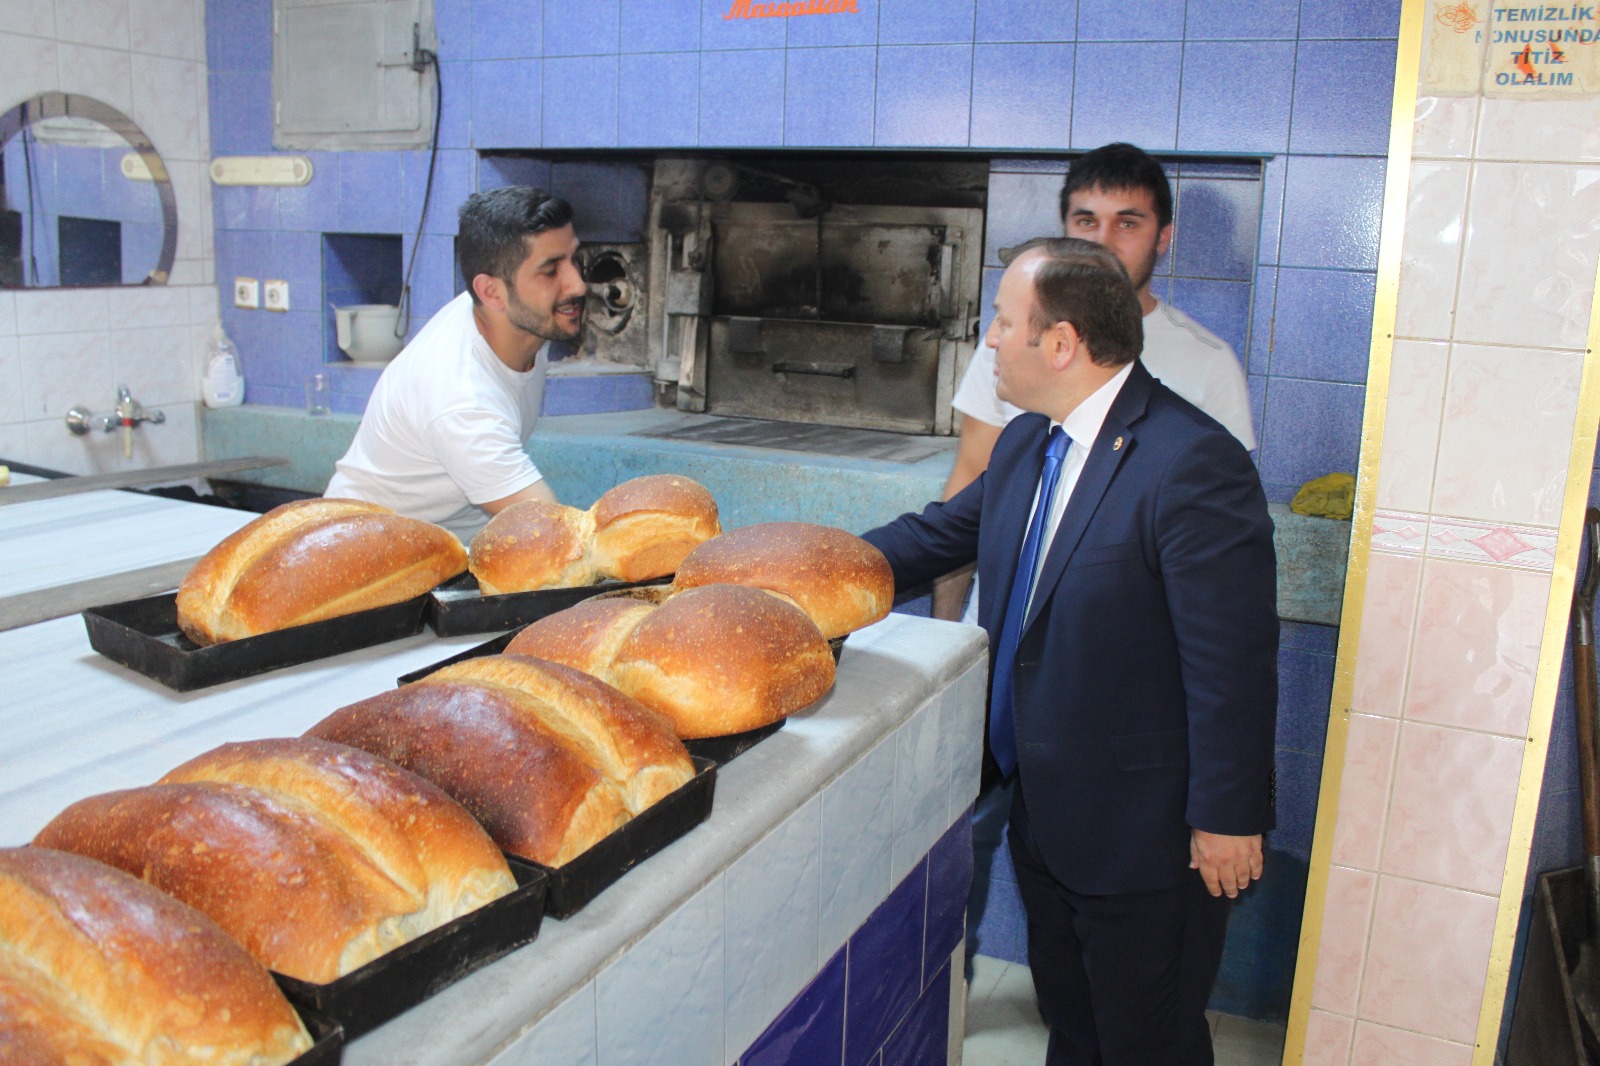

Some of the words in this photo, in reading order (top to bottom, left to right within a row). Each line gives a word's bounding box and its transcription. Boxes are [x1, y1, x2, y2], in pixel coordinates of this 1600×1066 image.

[1494, 5, 1594, 22] TEMİZLİK
[1510, 48, 1565, 65] TİTİZ
[1495, 72, 1573, 86] OLALIM
